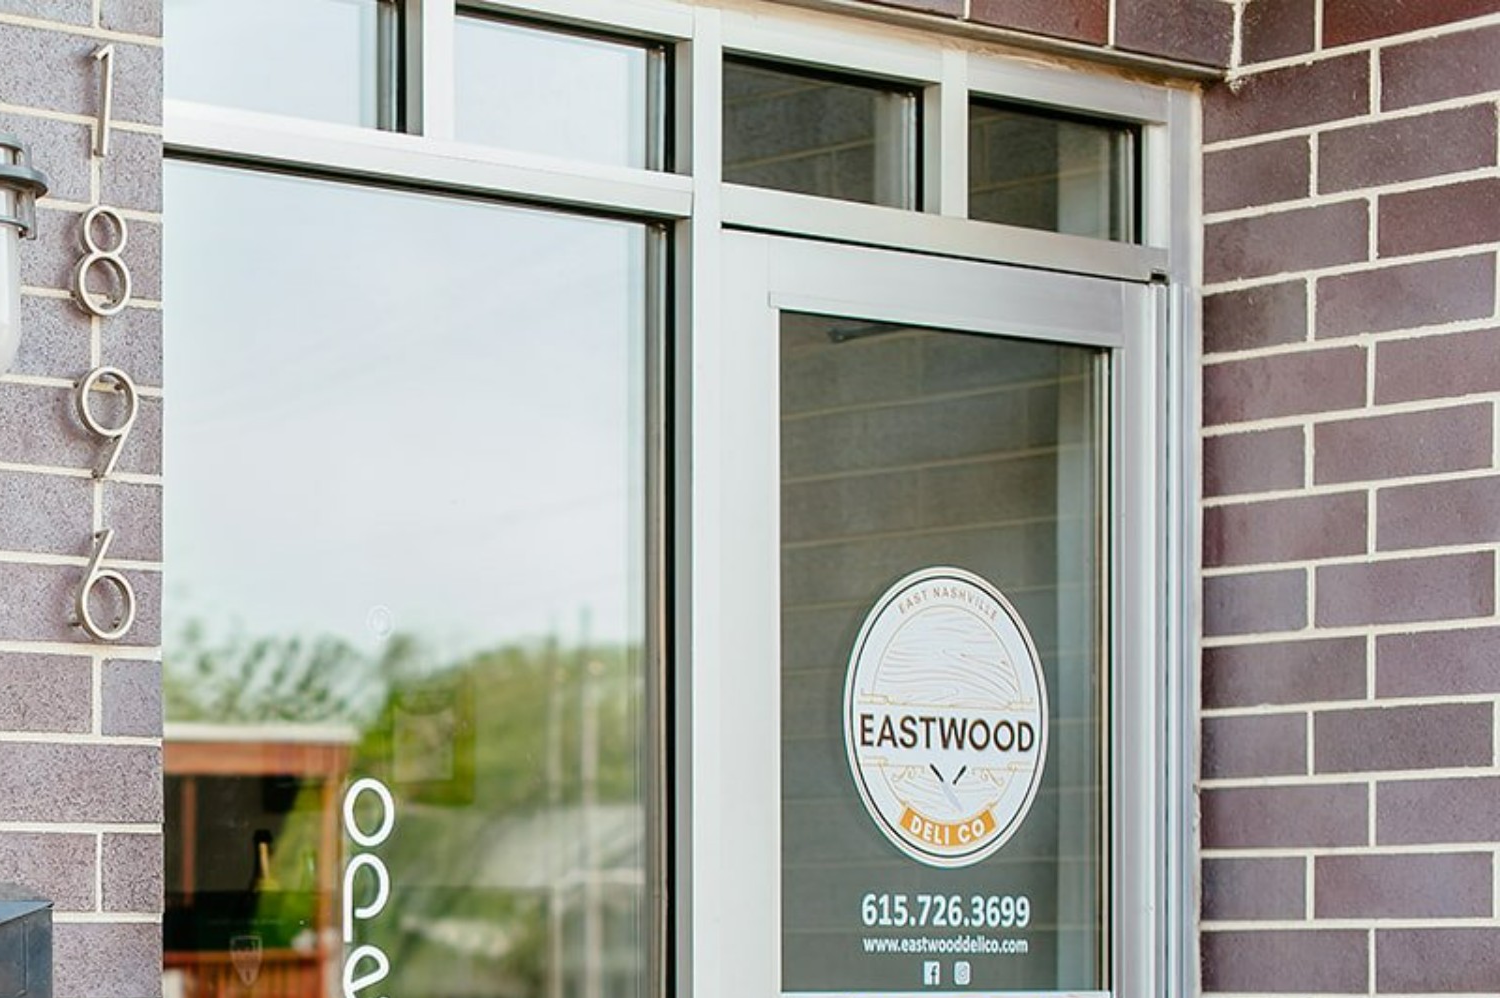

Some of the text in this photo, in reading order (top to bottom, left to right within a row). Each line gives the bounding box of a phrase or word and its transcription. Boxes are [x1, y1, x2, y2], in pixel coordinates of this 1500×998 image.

[76, 44, 138, 641] 1896
[898, 586, 998, 622] EAST NASHVILLE
[859, 713, 1036, 753] EASTWOOD
[909, 815, 986, 846] DELI CO
[861, 893, 1031, 927] 615.726.3699
[862, 934, 1029, 954] www.eastwooddelico.com
